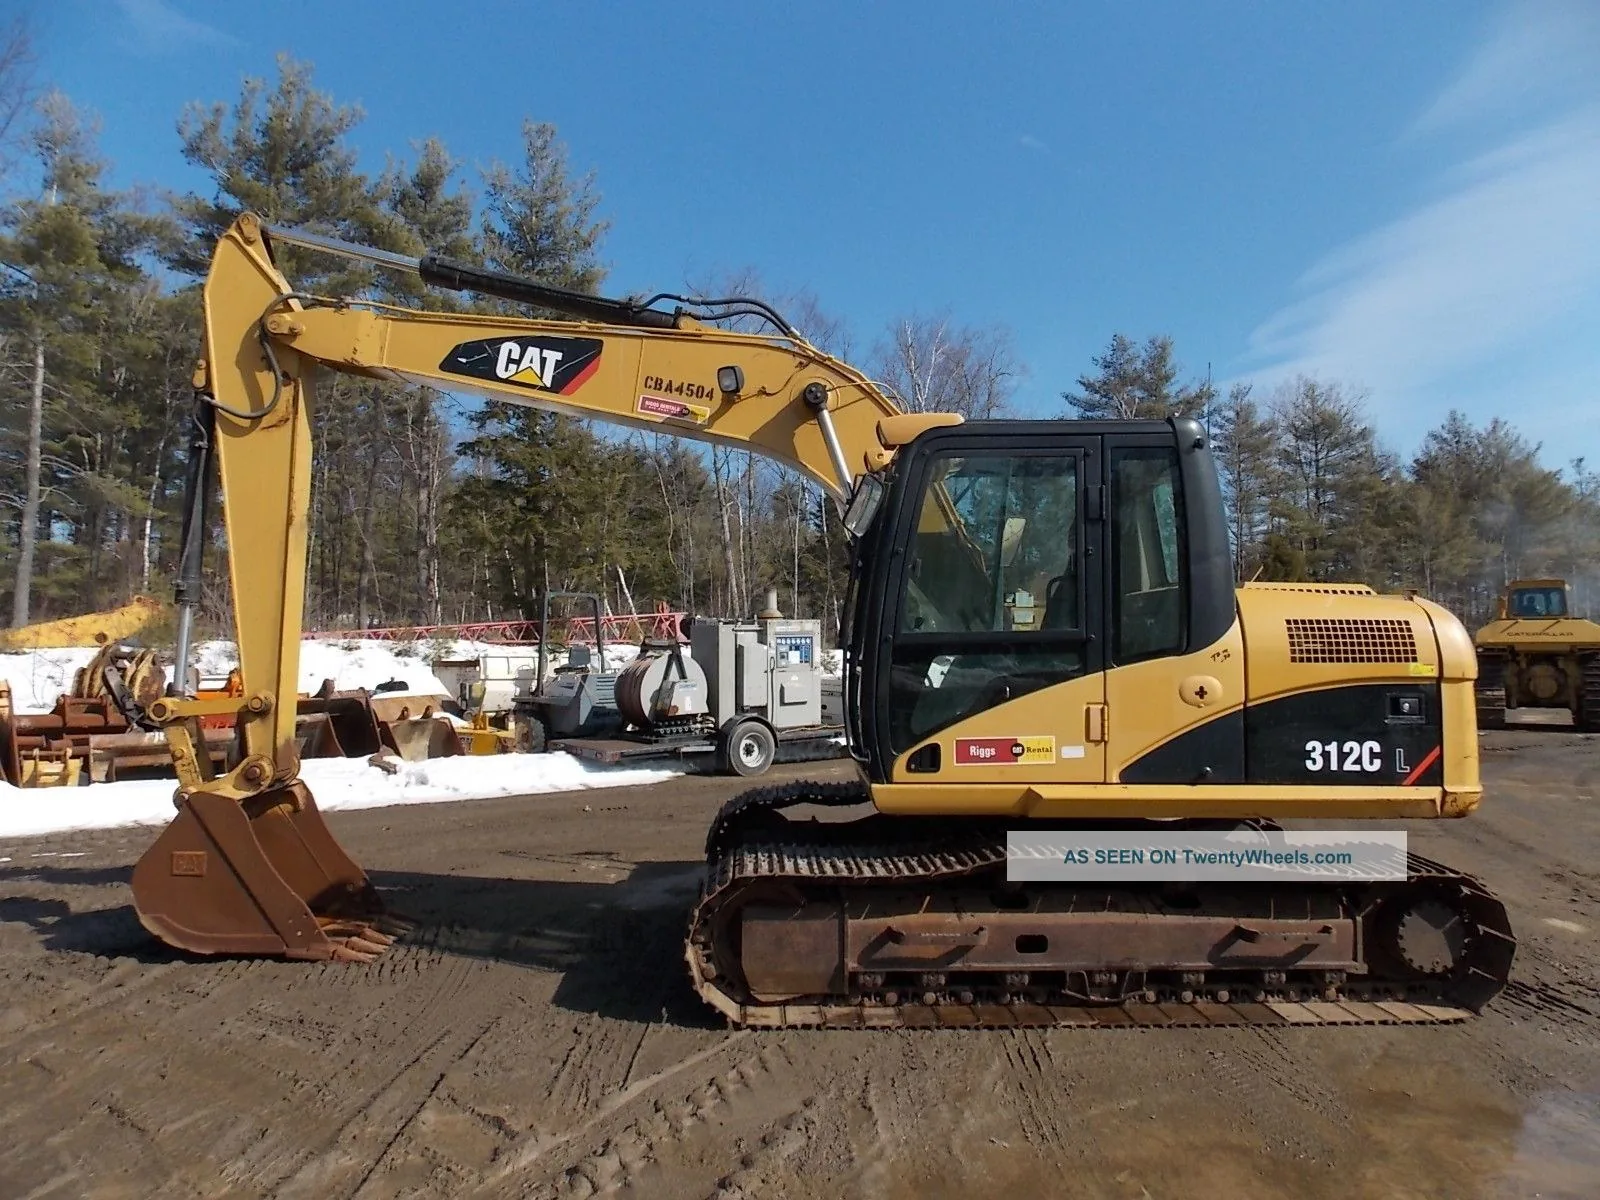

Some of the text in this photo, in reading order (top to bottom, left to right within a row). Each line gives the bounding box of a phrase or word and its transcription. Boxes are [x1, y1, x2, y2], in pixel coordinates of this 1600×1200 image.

[496, 341, 563, 388] CAT
[644, 375, 714, 401] CBA4504
[969, 745, 996, 758] Riggs
[1305, 740, 1410, 773] 312C L
